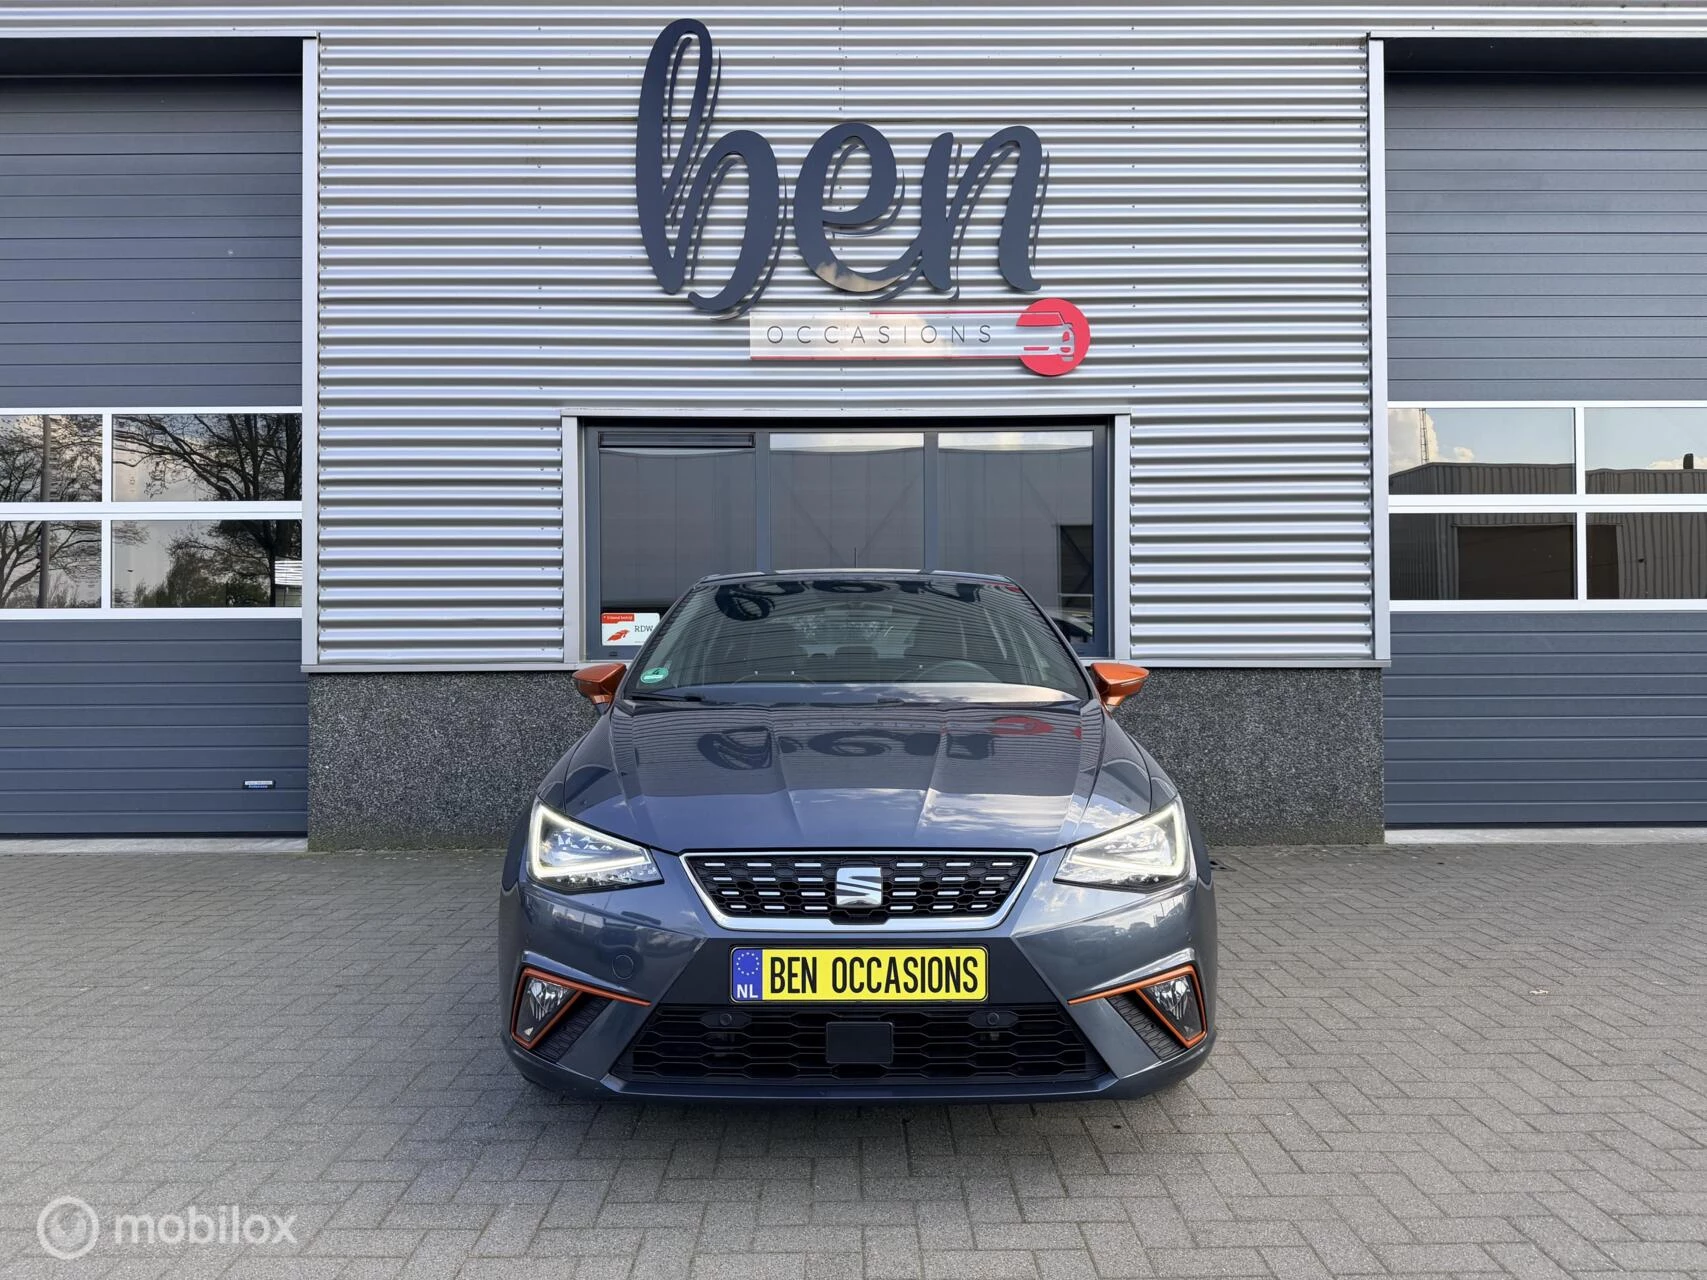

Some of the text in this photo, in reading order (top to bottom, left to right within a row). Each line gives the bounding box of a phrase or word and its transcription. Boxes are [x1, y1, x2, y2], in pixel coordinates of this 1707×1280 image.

[636, 18, 1043, 313] ben
[766, 324, 991, 344] OCCASIONS
[770, 956, 978, 994] BEN OCCASIONS
[736, 984, 758, 999] NL
